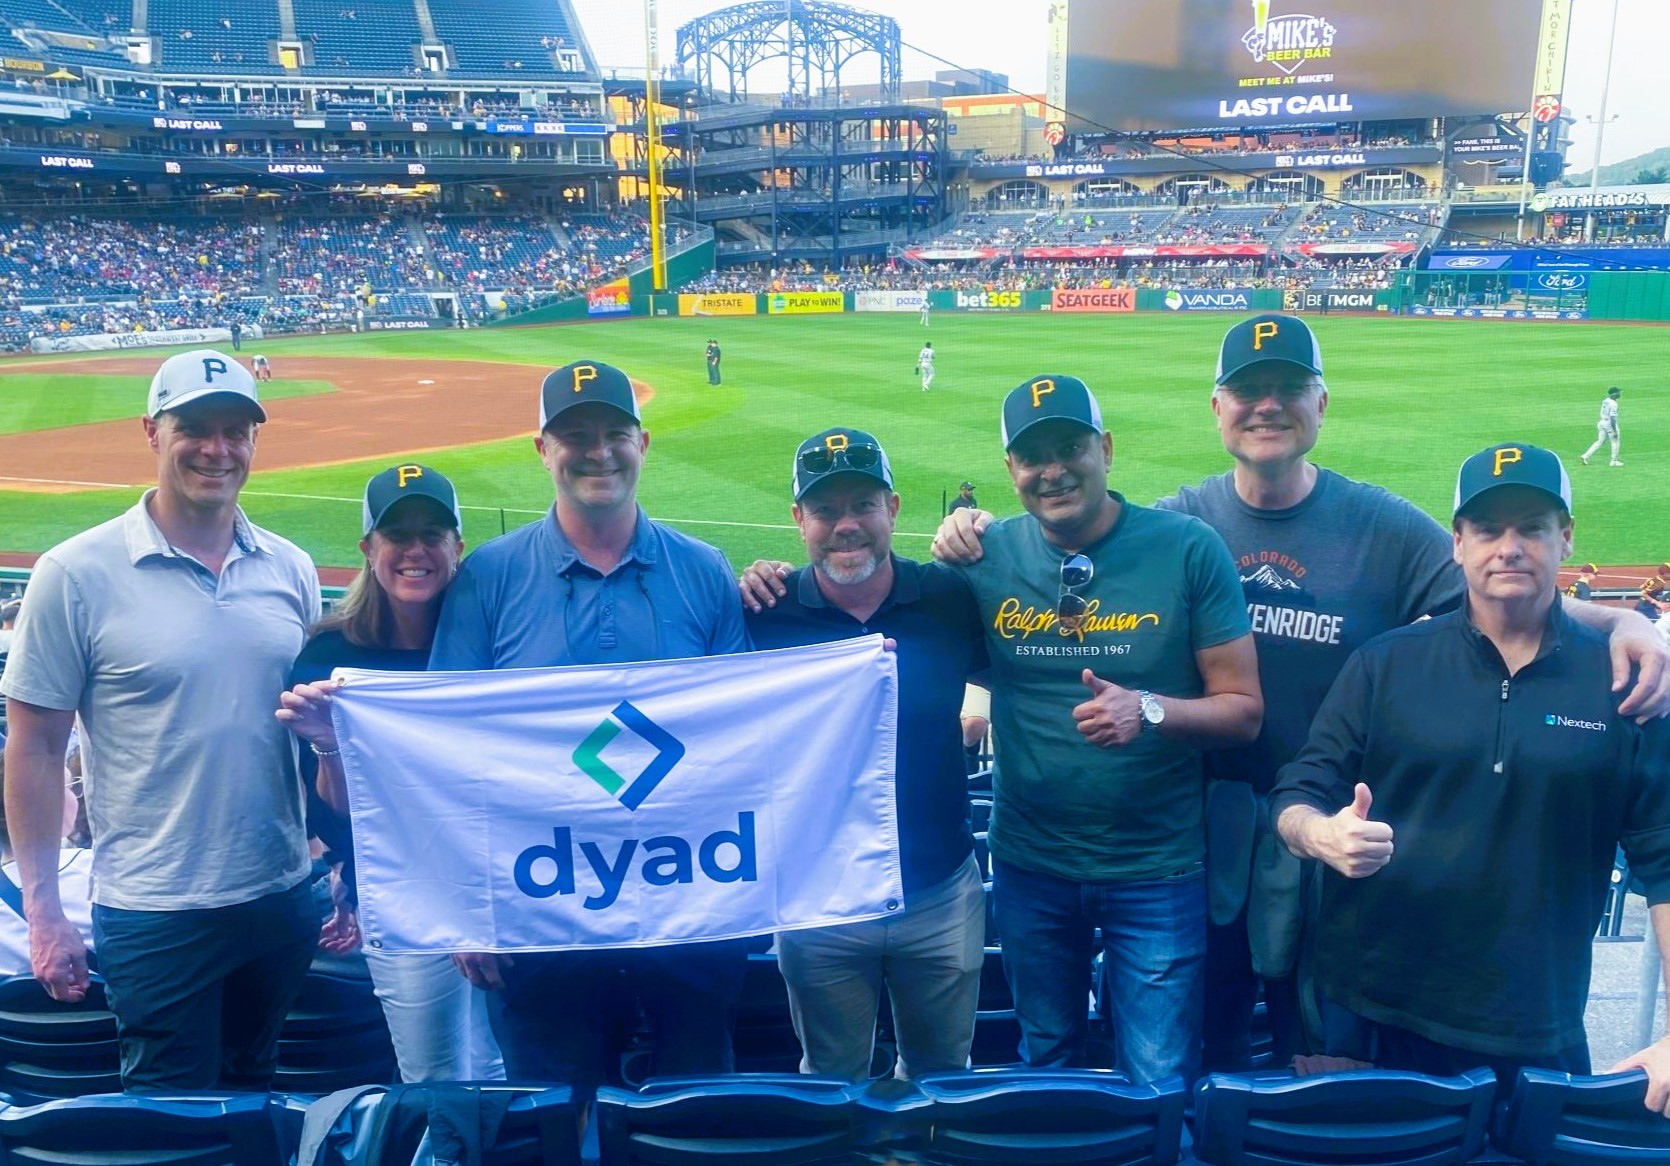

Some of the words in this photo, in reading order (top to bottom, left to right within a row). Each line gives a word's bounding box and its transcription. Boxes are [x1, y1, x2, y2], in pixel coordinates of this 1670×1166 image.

[1267, 17, 1336, 50] MIKE'S
[1266, 49, 1301, 61] BEER
[1304, 47, 1331, 59] BAR
[1239, 78, 1265, 87] MEET
[1267, 77, 1282, 85] ME
[1283, 76, 1296, 85] AT
[1297, 74, 1334, 84] MIKE'S!
[1219, 97, 1283, 118] LAST
[1286, 93, 1353, 115] CALL
[168, 119, 192, 129] LAST
[193, 120, 223, 130] CALL
[497, 124, 524, 132] KOPPERS
[41, 156, 67, 167] LAST
[68, 157, 94, 168] CALL
[1297, 155, 1331, 166] LAST
[1331, 153, 1366, 165] CALL
[268, 164, 295, 173] LAST
[296, 164, 325, 173] CALL
[1045, 165, 1074, 175] LAST
[1074, 164, 1105, 174] CALL
[1546, 274, 1577, 286] Ford
[703, 299, 743, 307] TRISTATE
[789, 298, 811, 307] PLAY
[820, 298, 841, 307] WIN!
[896, 297, 922, 307] paze
[957, 291, 1021, 307] bet365
[1057, 293, 1129, 308] SEATGEEK
[1184, 294, 1248, 305] VANDA
[384, 321, 406, 329] LAST
[1254, 321, 1278, 350] P
[202, 358, 227, 383] P
[572, 365, 598, 392] P
[1031, 379, 1055, 408] P
[1493, 447, 1522, 476] P
[397, 465, 423, 488] P
[994, 597, 1058, 639] Ralph
[1247, 603, 1344, 645] ENRIDGE
[1016, 645, 1100, 656] ESTABLISHED
[1104, 644, 1131, 655] 1967
[1557, 715, 1607, 731] Nextech
[513, 811, 757, 910] dyad
